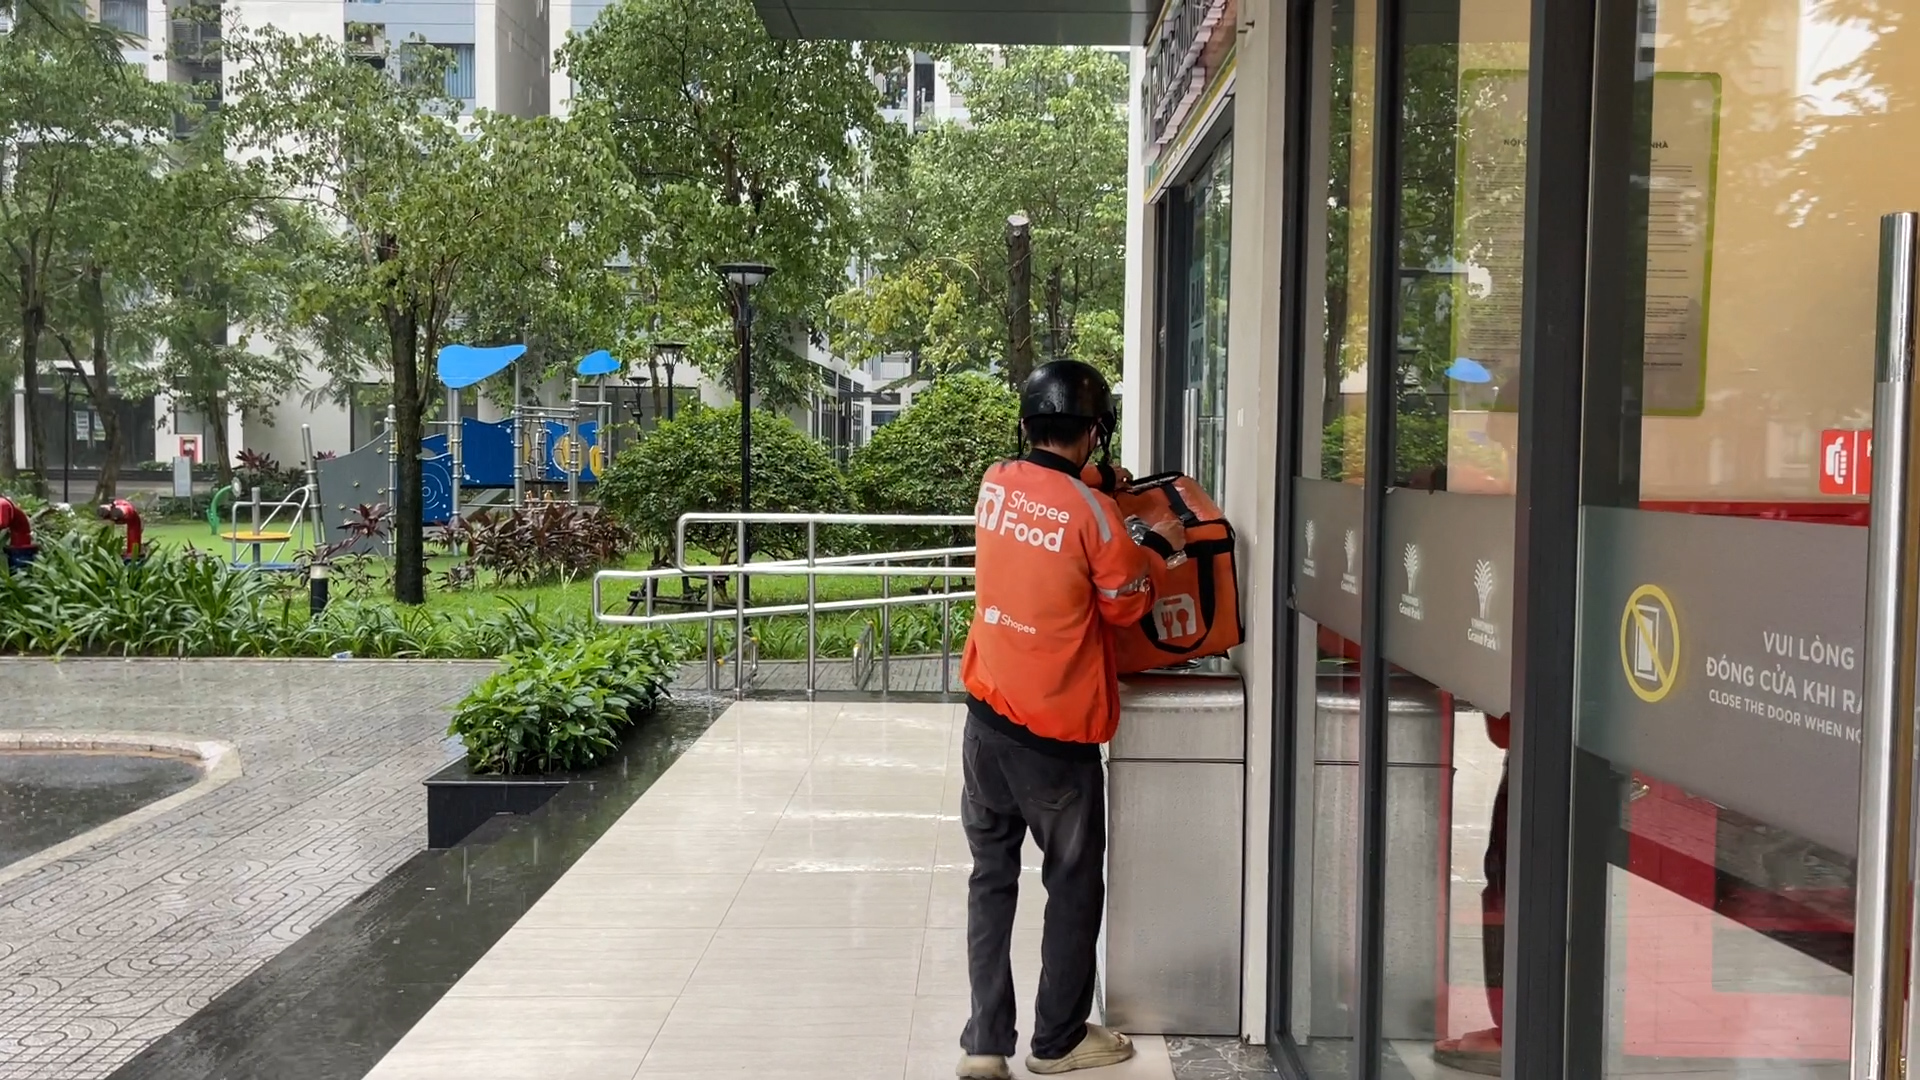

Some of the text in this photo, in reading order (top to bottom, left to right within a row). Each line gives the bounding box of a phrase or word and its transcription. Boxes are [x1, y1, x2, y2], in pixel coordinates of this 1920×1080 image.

[1008, 490, 1069, 523] Shopee
[999, 510, 1064, 552] Food
[1000, 614, 1036, 635] Shopee
[1763, 631, 1855, 670] VUI LÒNG
[1706, 654, 1755, 687] ĐÓNG
[1760, 664, 1797, 699] CỬA
[1803, 679, 1836, 708] KHI
[1708, 689, 1742, 710] CLOSE
[1744, 698, 1765, 716] THE
[1767, 705, 1801, 727] DOOR
[1804, 715, 1843, 738] WHEN
